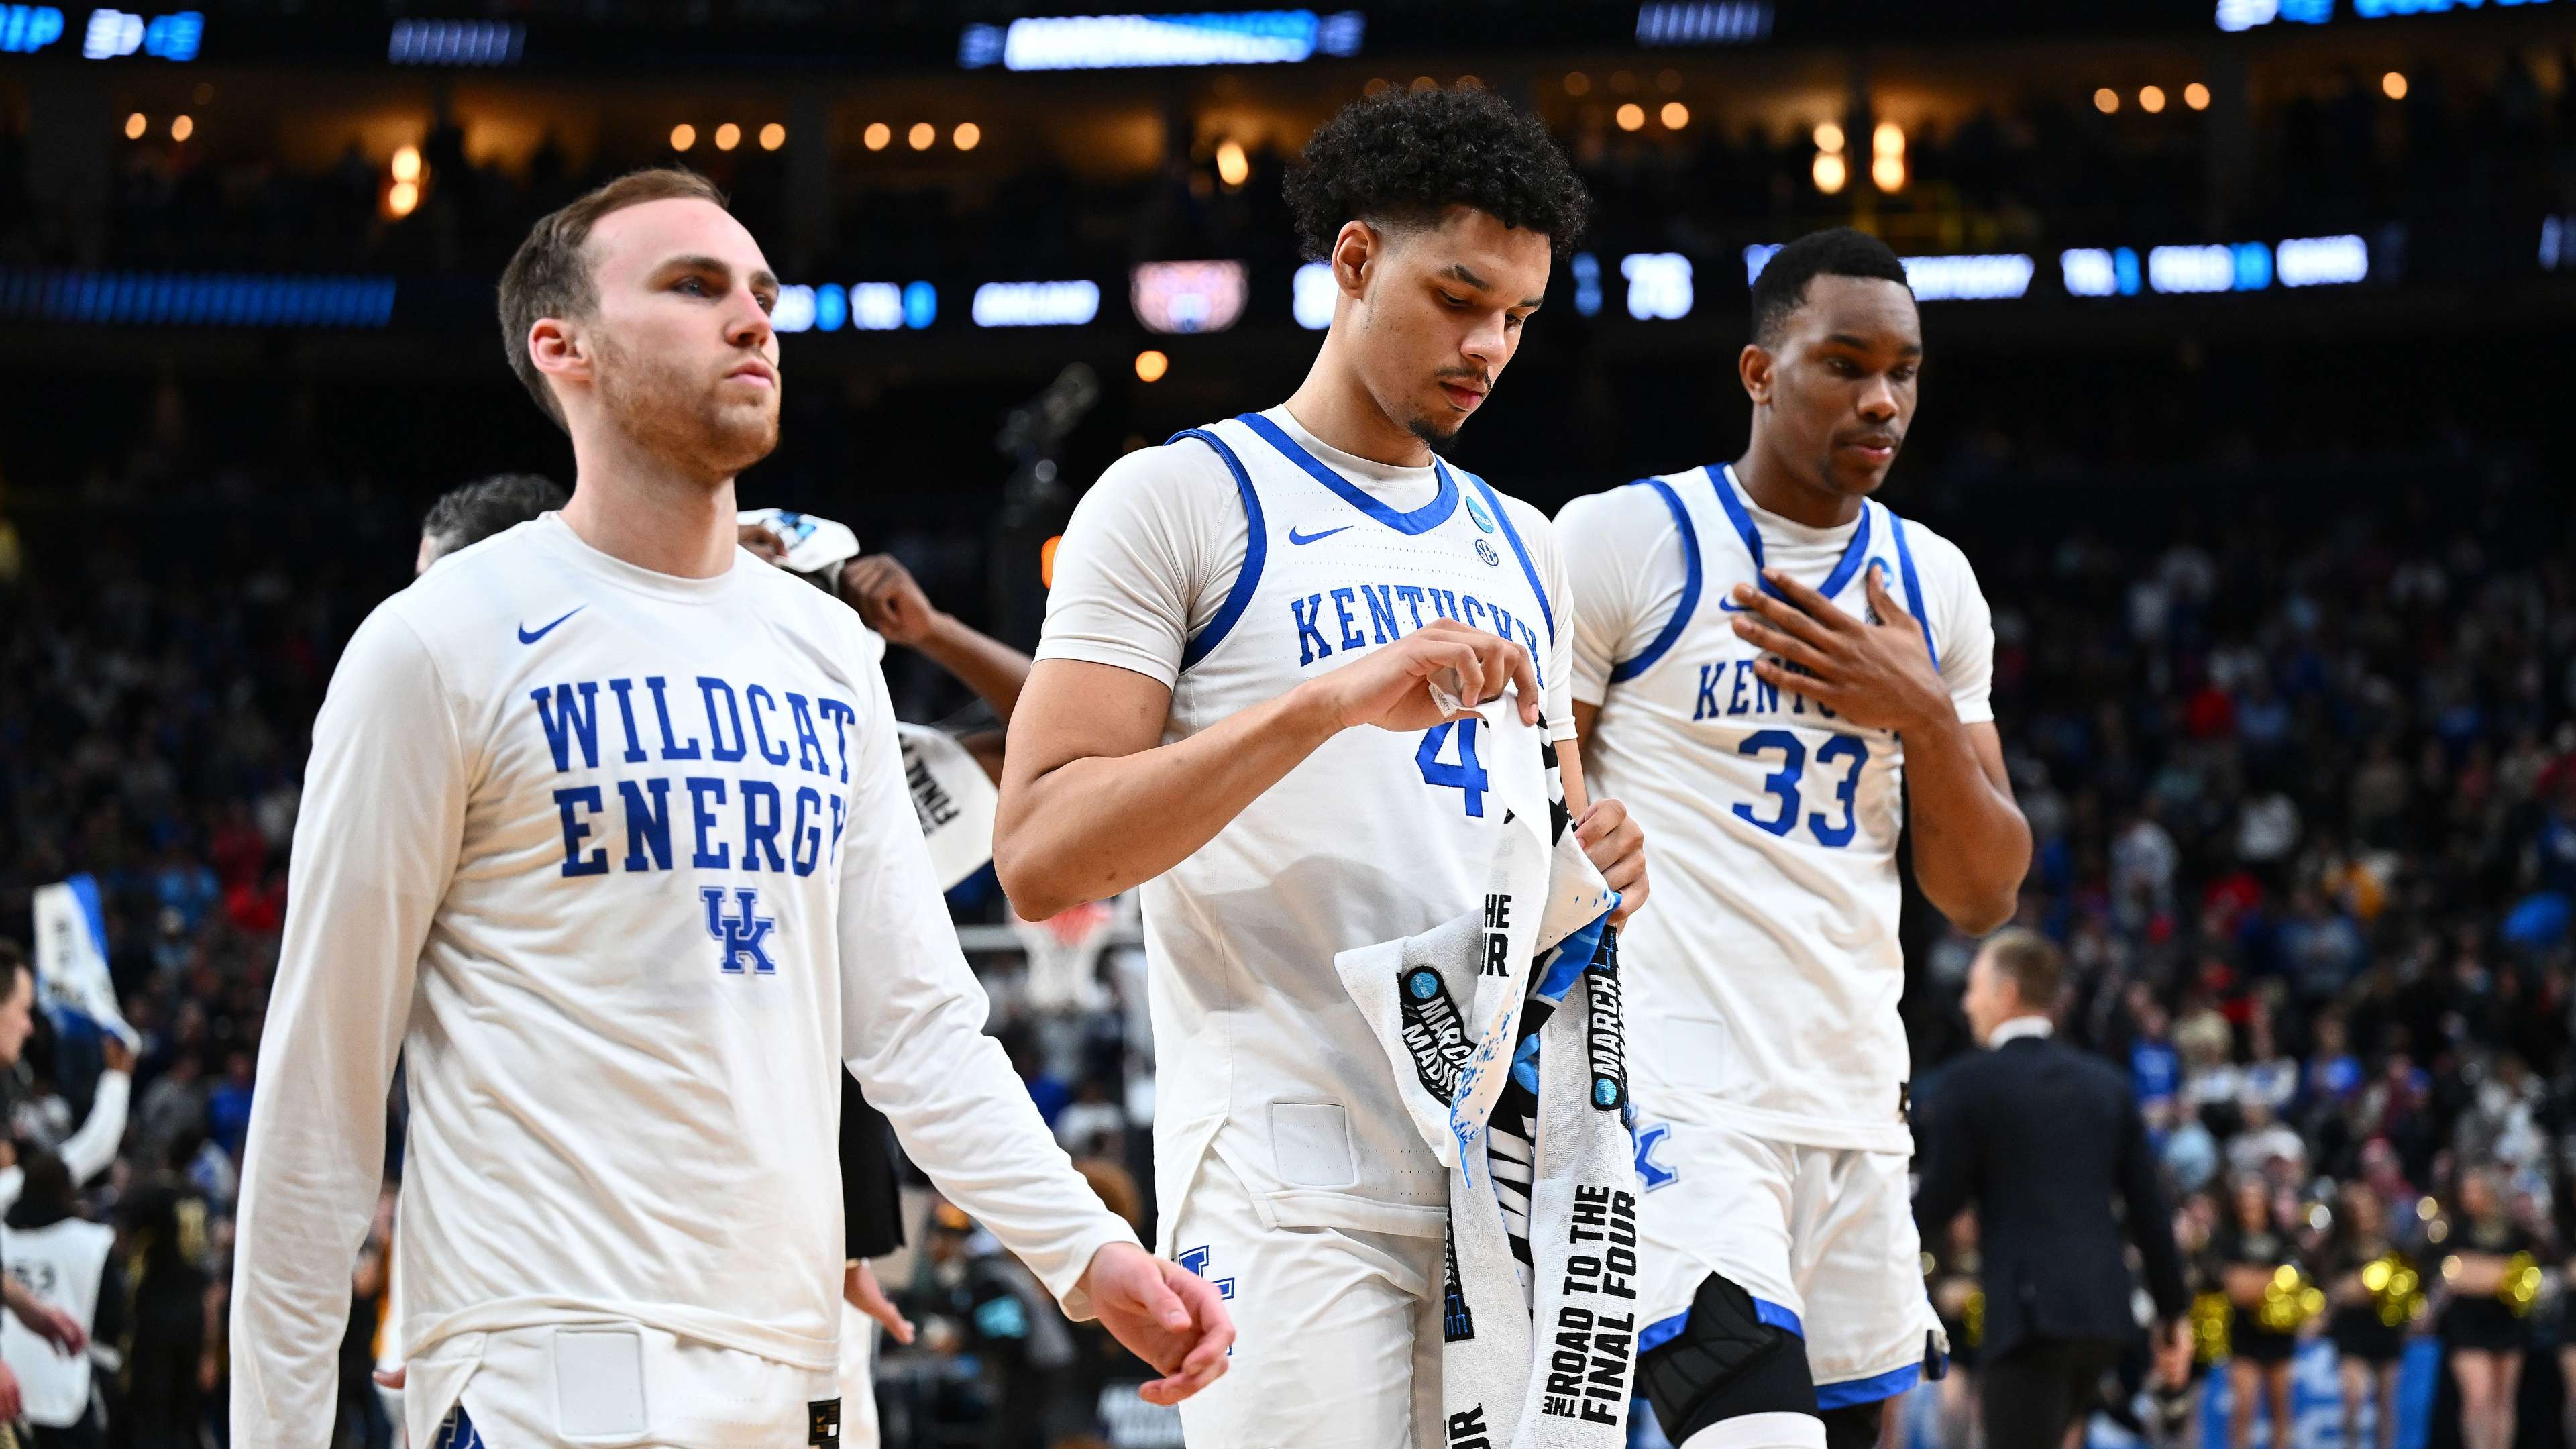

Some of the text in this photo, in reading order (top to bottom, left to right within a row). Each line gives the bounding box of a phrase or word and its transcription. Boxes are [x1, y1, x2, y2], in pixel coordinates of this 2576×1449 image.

[1477, 539, 1499, 566] SEC
[529, 676, 856, 784] WILDCAT
[1415, 718, 1489, 818] 4
[553, 777, 847, 884] ENERGY
[1733, 729, 1869, 848] 33
[699, 885, 776, 975] UK
[1484, 894, 1512, 929] HE
[1589, 973, 1620, 1079] MARCH
[1542, 1185, 1610, 1418] THE ROAD TO THE
[1580, 1313, 1635, 1426] FINAL
